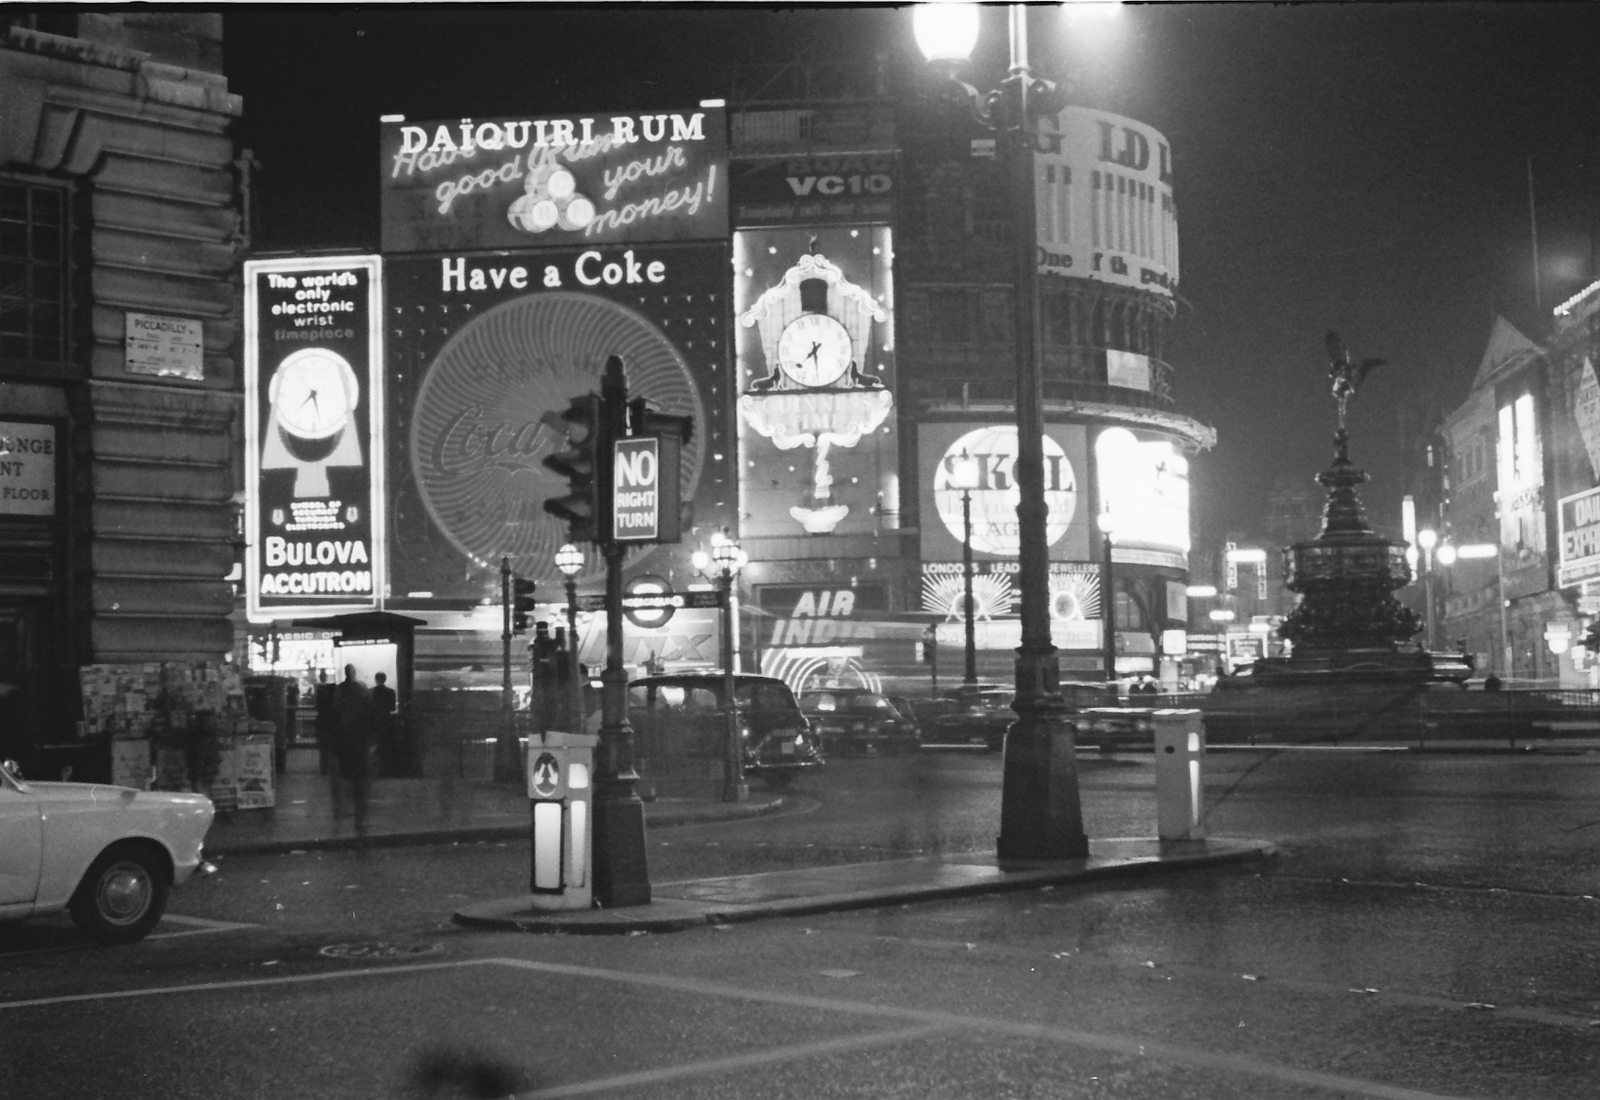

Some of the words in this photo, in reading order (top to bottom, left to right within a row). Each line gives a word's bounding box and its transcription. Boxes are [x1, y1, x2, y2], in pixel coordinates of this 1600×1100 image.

[400, 117, 595, 153] DAÏQUIRI
[610, 113, 705, 144] RUM
[1033, 113, 1150, 171] GLD
[436, 155, 523, 214] good
[604, 146, 685, 201] your
[786, 174, 893, 196] VC10
[585, 165, 716, 236] money!
[267, 273, 297, 289] The
[442, 257, 528, 292] Have
[543, 265, 562, 287] a
[575, 250, 666, 286] Coke
[295, 286, 331, 302] only
[271, 300, 354, 315] electronic
[134, 319, 187, 334] PICCADILLY
[294, 314, 334, 327] wrist
[274, 327, 354, 341] timepiece
[618, 450, 656, 487] NO
[943, 453, 1074, 491] SKL
[3, 487, 50, 501] FLOOR
[617, 491, 655, 508] RIGHT
[618, 511, 654, 528] TURN
[265, 536, 369, 567] BULOVA
[922, 562, 980, 574] LONDOS
[991, 562, 1021, 574] LEAD
[1048, 563, 1100, 574] JEWELLERS
[260, 570, 371, 594] ACCUTRON
[792, 590, 855, 617] AIR
